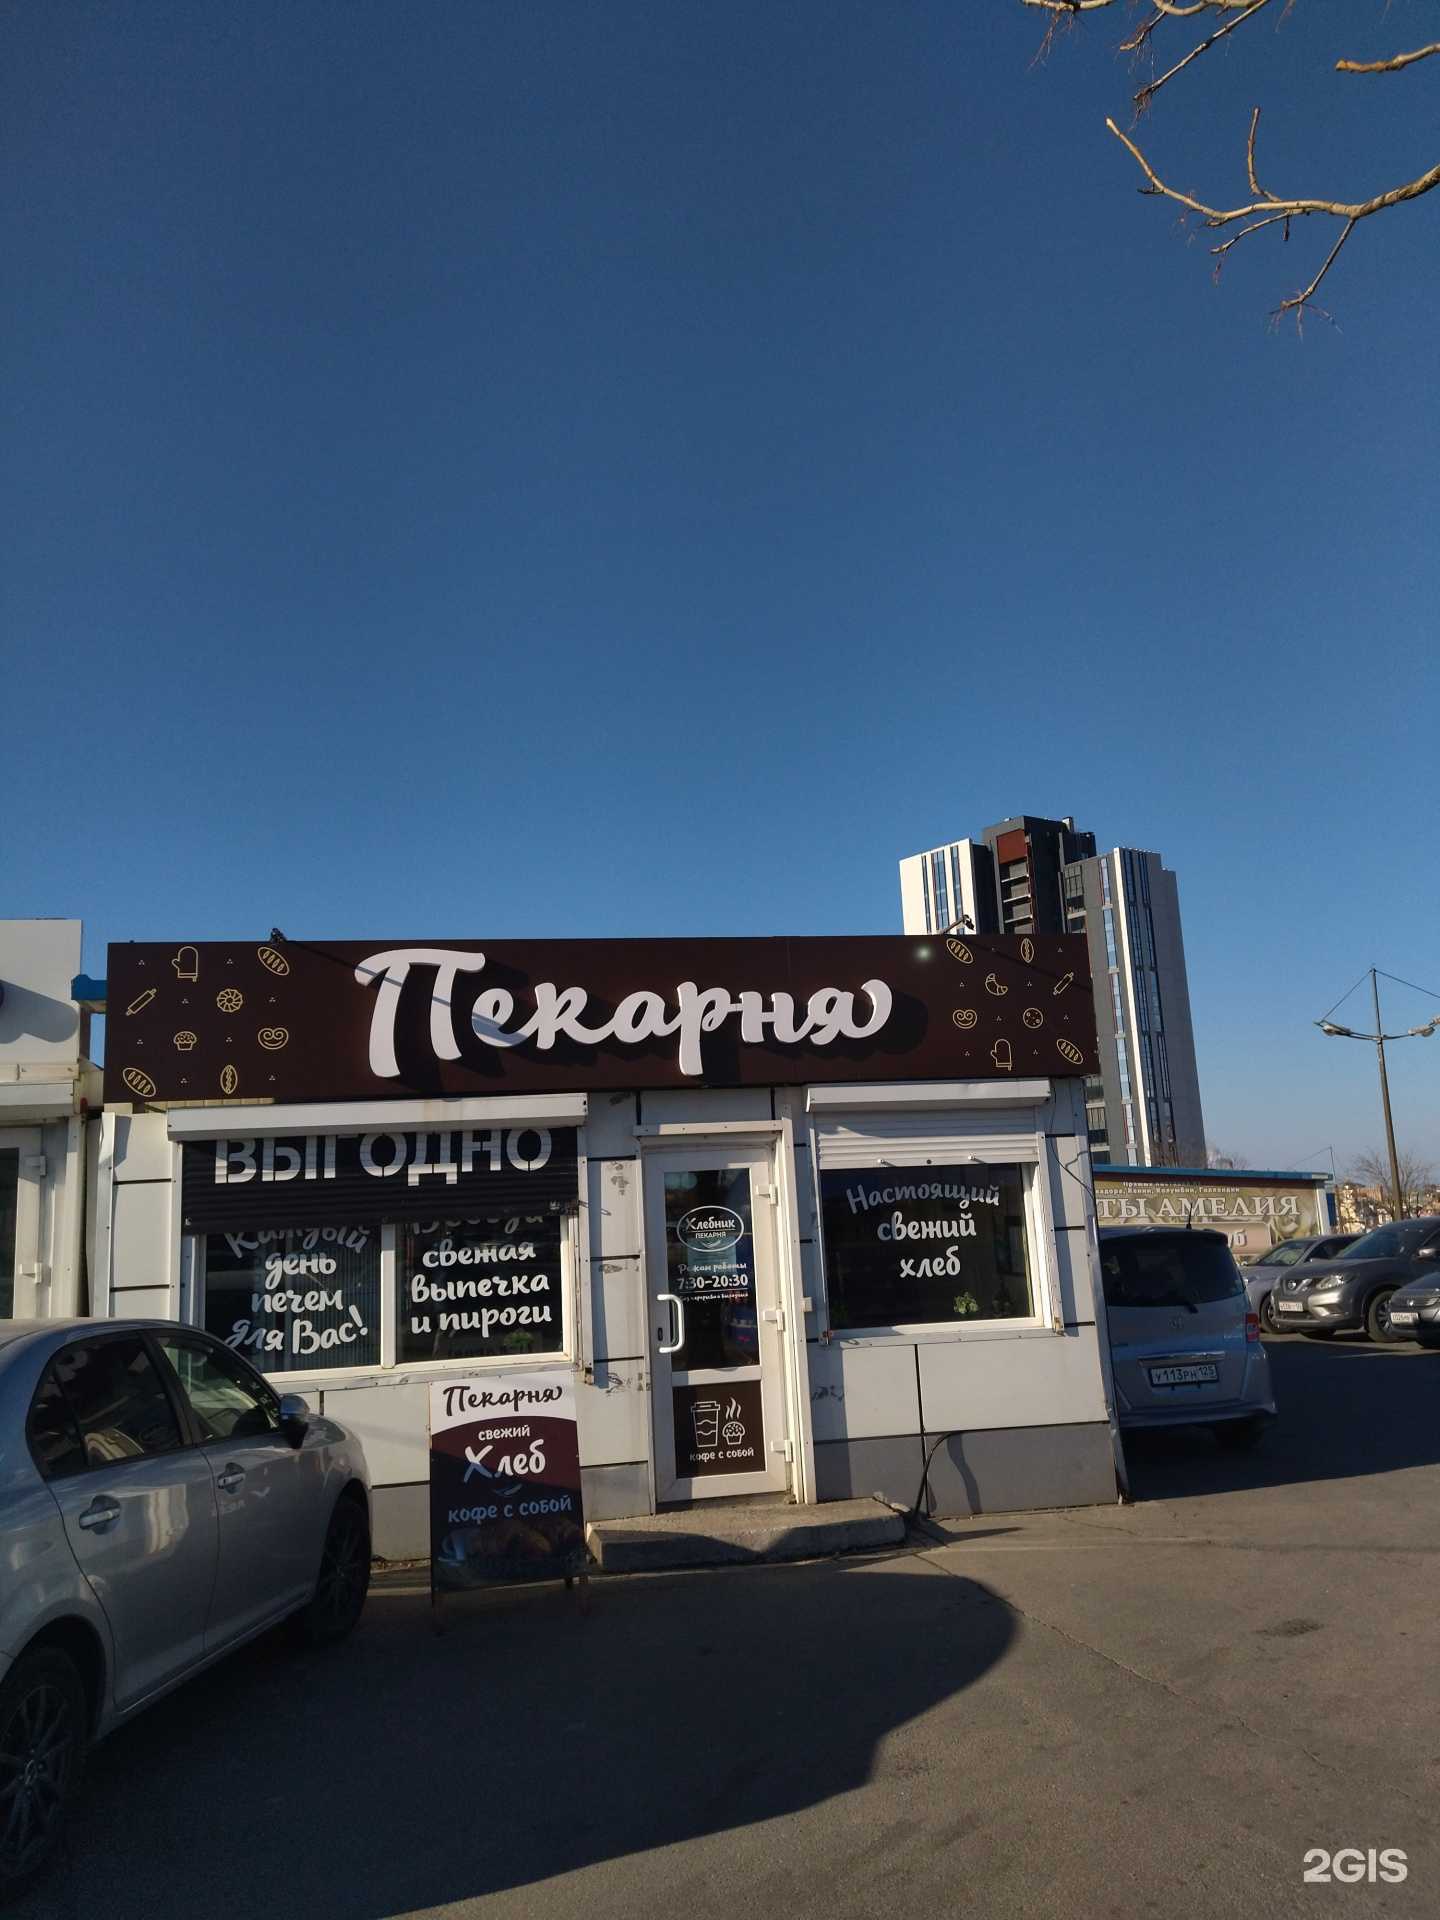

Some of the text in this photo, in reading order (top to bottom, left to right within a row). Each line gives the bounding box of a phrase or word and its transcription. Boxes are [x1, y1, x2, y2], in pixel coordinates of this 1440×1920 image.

[354, 948, 893, 1077] Пекарня
[214, 1128, 552, 1187] ВЫГОДНО
[846, 1183, 1000, 1214] Настоящий
[1096, 1195, 1300, 1218] ТЫ АМЕЛИЯ
[686, 1216, 736, 1230] Хлебник
[695, 1231, 727, 1239] ПЕКАРНЯ
[877, 1211, 977, 1241] свежий
[422, 1238, 536, 1268] свежая
[900, 1245, 961, 1278] хлеб
[265, 1252, 337, 1290] день
[251, 1289, 343, 1313] печем
[411, 1274, 549, 1303] выпечка
[224, 1304, 369, 1354] для Вас!
[411, 1305, 552, 1338] и пироги
[442, 1385, 563, 1417] Пекарня
[478, 1424, 531, 1441] свежий
[463, 1438, 546, 1483] Хлеб
[690, 1451, 715, 1462] кофе
[726, 1447, 754, 1457] собой
[448, 1494, 572, 1524] кофе с собой
